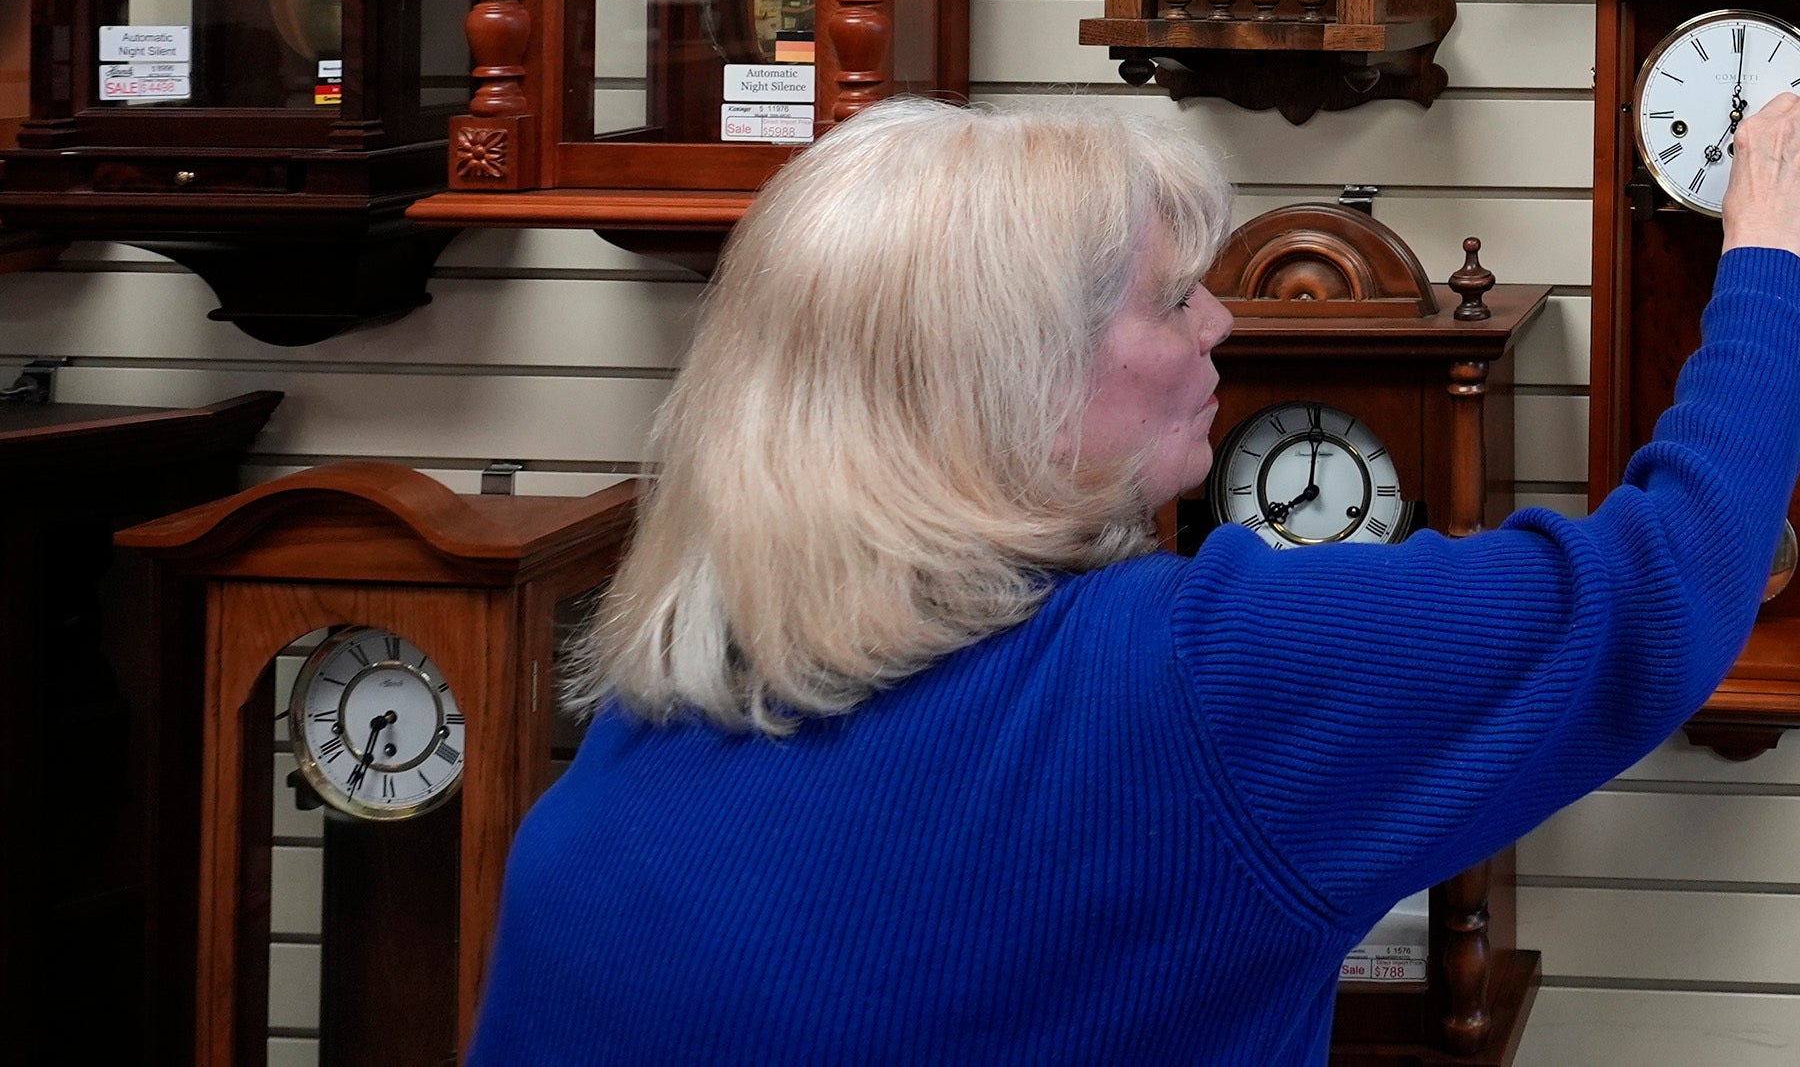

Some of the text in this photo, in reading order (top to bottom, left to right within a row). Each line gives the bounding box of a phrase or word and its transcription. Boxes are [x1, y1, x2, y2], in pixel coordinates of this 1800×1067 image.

[122, 33, 173, 42] Automatic
[119, 46, 176, 58] Night Silent
[746, 68, 798, 78] Automatic
[106, 82, 138, 94] SALE
[741, 82, 806, 93] Night Silence
[727, 124, 751, 133] Sale
[1342, 965, 1365, 975] Sale
[1375, 966, 1405, 978] $788
